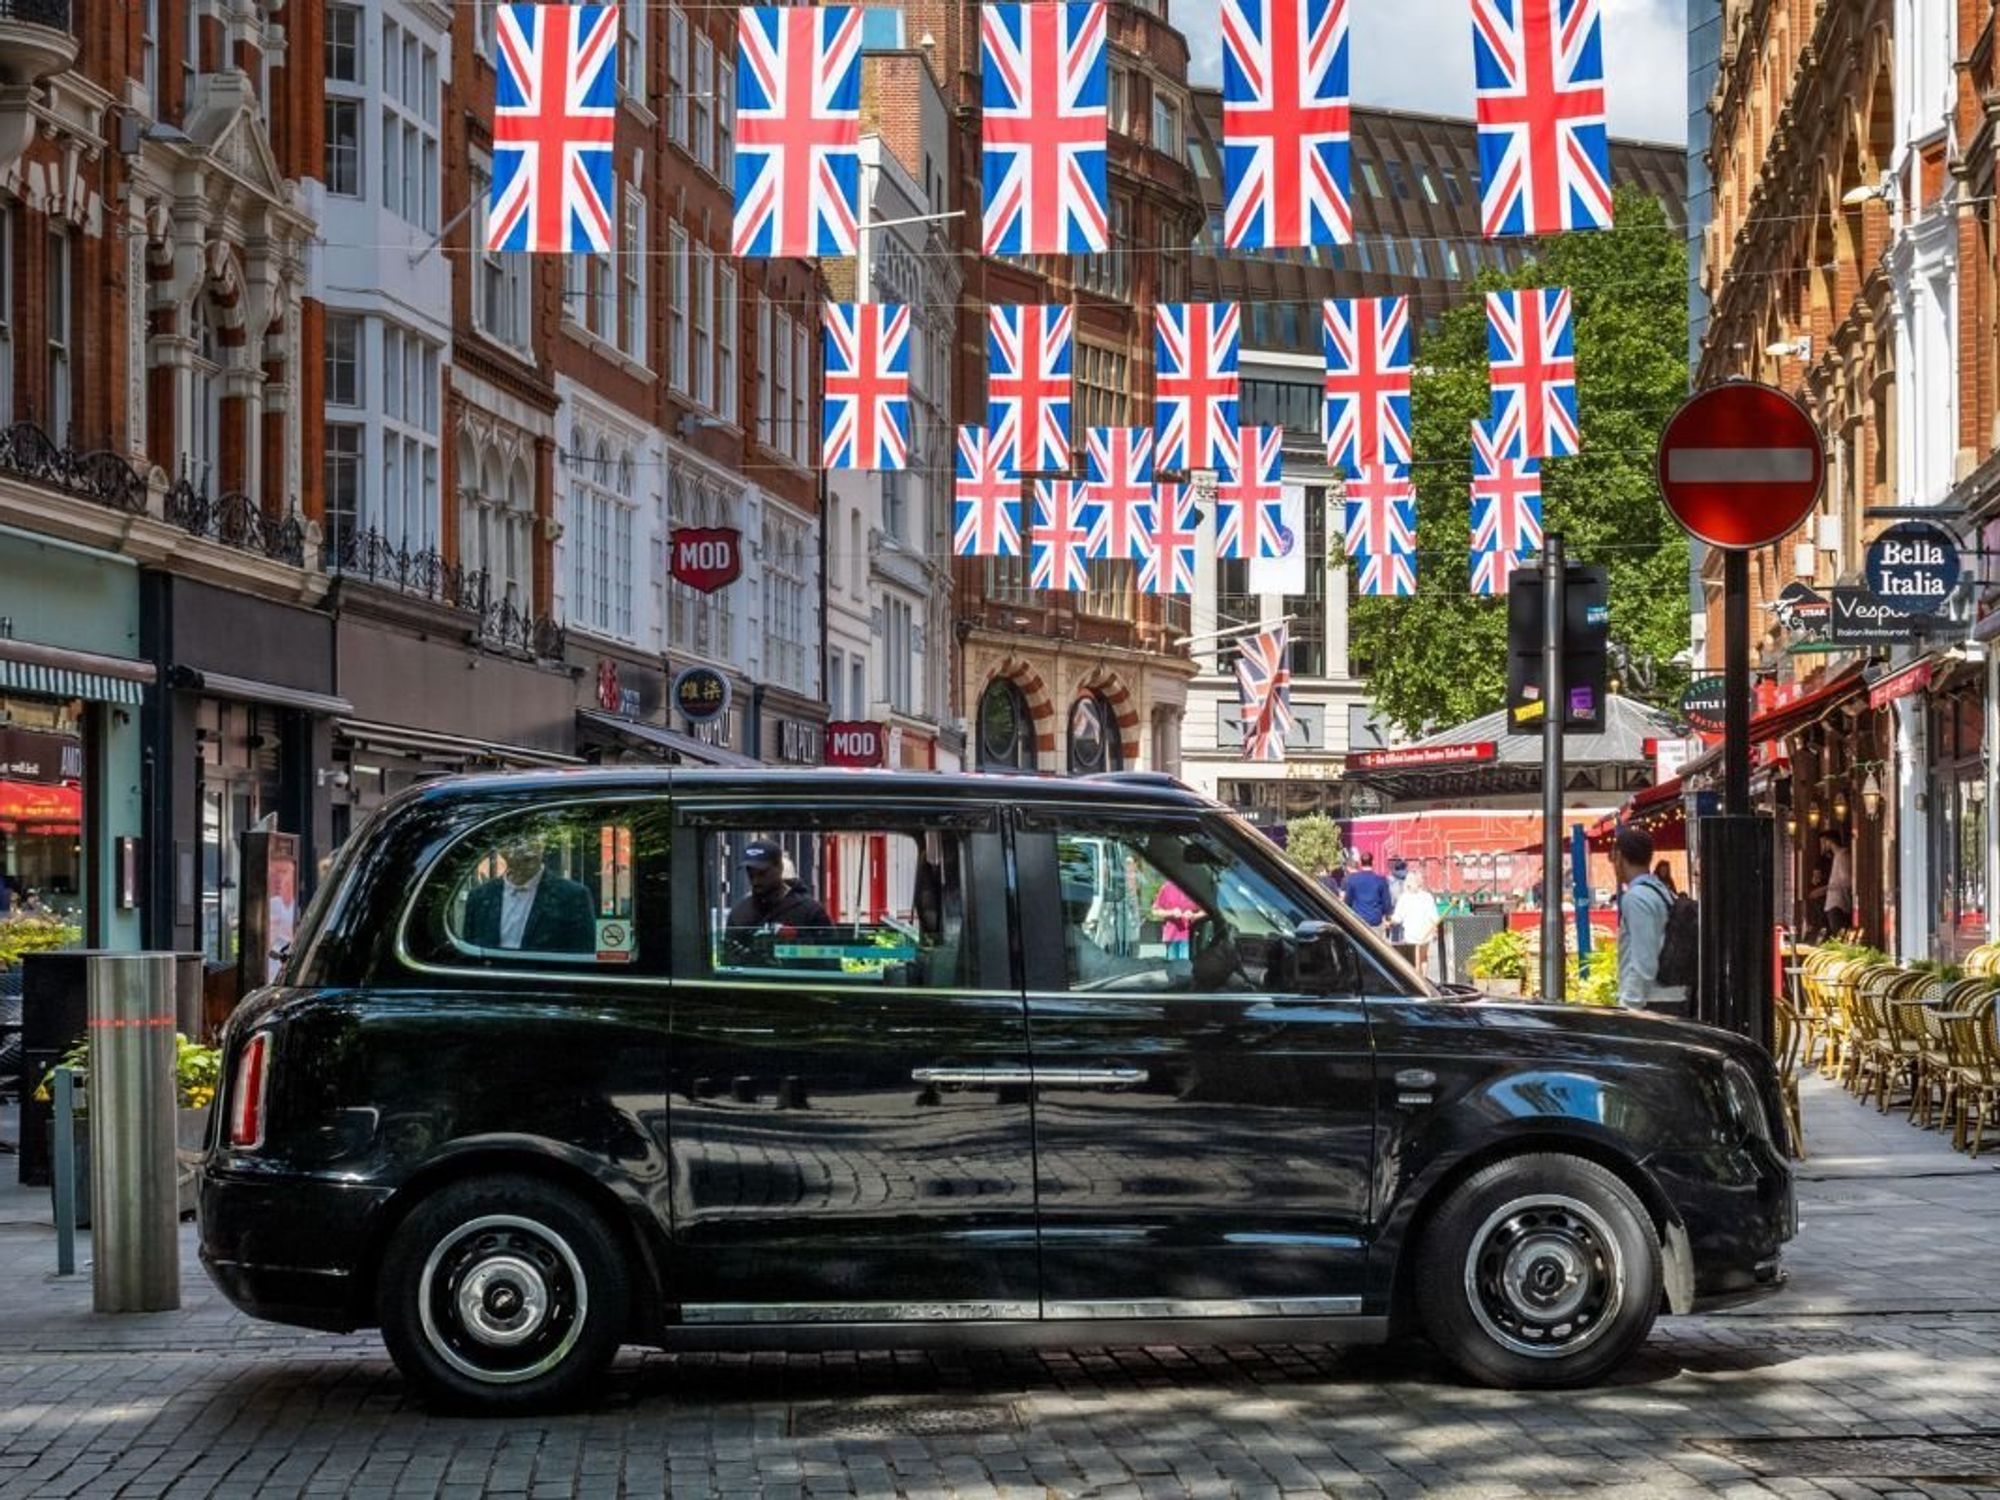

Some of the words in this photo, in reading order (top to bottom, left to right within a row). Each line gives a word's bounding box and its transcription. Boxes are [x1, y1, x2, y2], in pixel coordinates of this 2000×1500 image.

[679, 541, 730, 570] MOD
[1879, 540, 1945, 565] Bella
[1879, 571, 1946, 596] Italia
[1684, 699, 1720, 710] LITTLE
[833, 732, 875, 756] MOD
